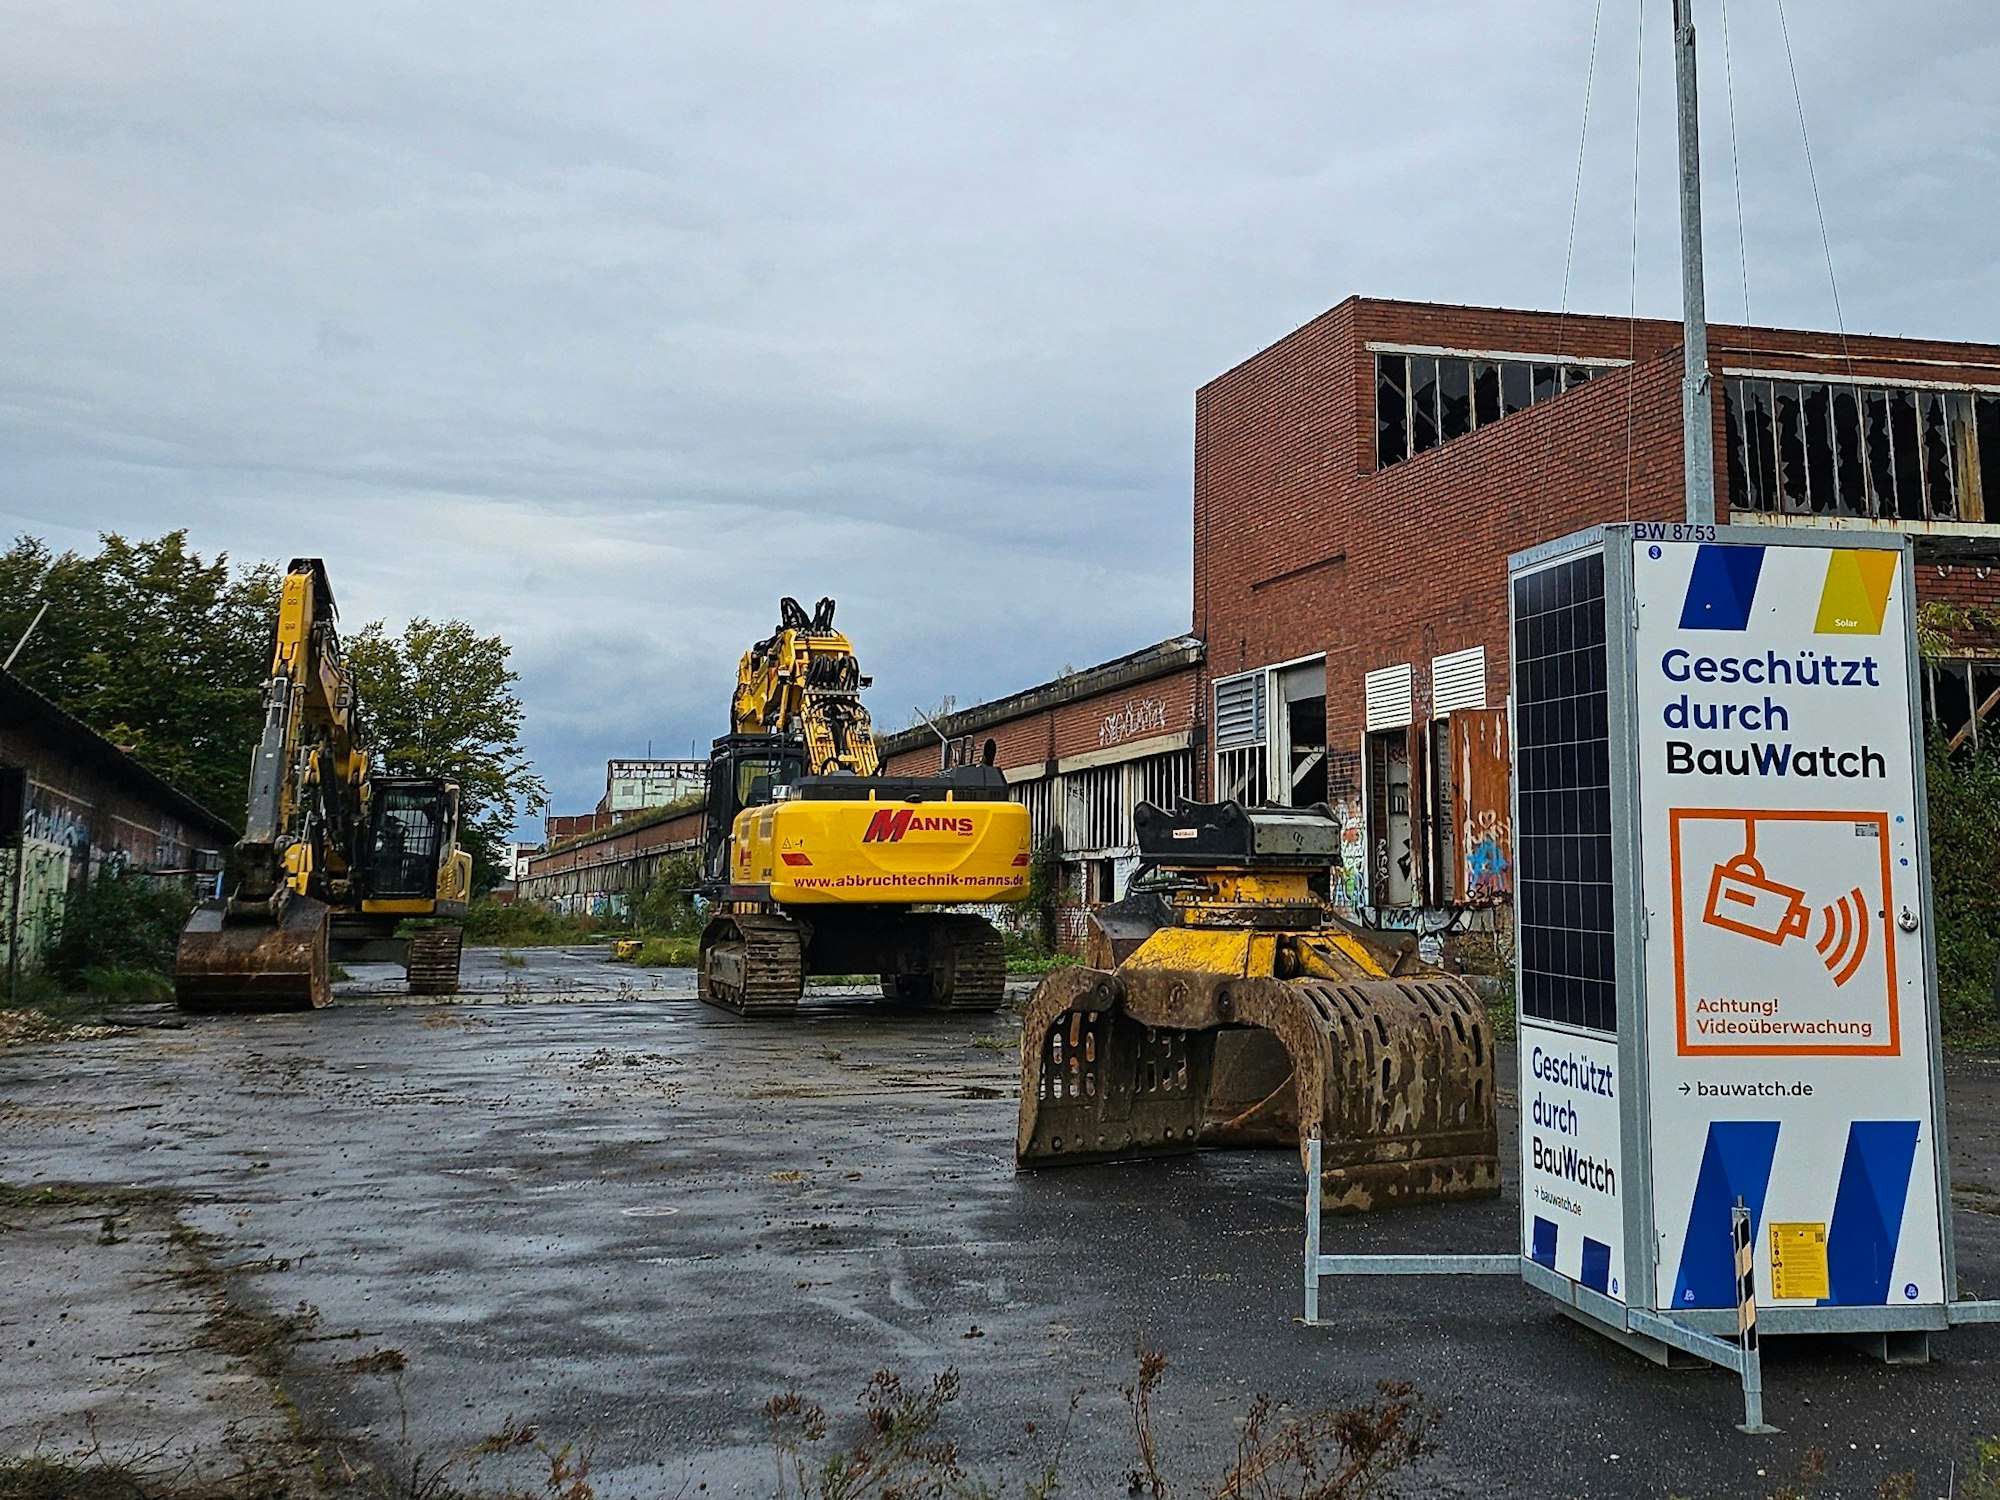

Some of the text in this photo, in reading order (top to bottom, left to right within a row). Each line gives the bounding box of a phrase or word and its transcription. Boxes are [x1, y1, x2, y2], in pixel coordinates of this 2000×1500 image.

[1634, 522, 1716, 541] BW 8753
[1834, 618, 1858, 628] Solar
[1661, 649, 1880, 687] Geschützt
[1663, 694, 1789, 731] durch
[1666, 741, 1886, 778] BauWatch
[793, 874, 1024, 888] www.abbruchtechnik-manns.de
[1696, 998, 1779, 1017] Achtung!
[1696, 1018, 1873, 1037] Videoüberwachung
[1532, 1046, 1614, 1098] Geschützt
[1697, 1081, 1814, 1097] bauwatch.de
[1533, 1092, 1578, 1137] durch
[1533, 1135, 1616, 1197] BauWatch
[1540, 1185, 1582, 1217] bauwatch.de
